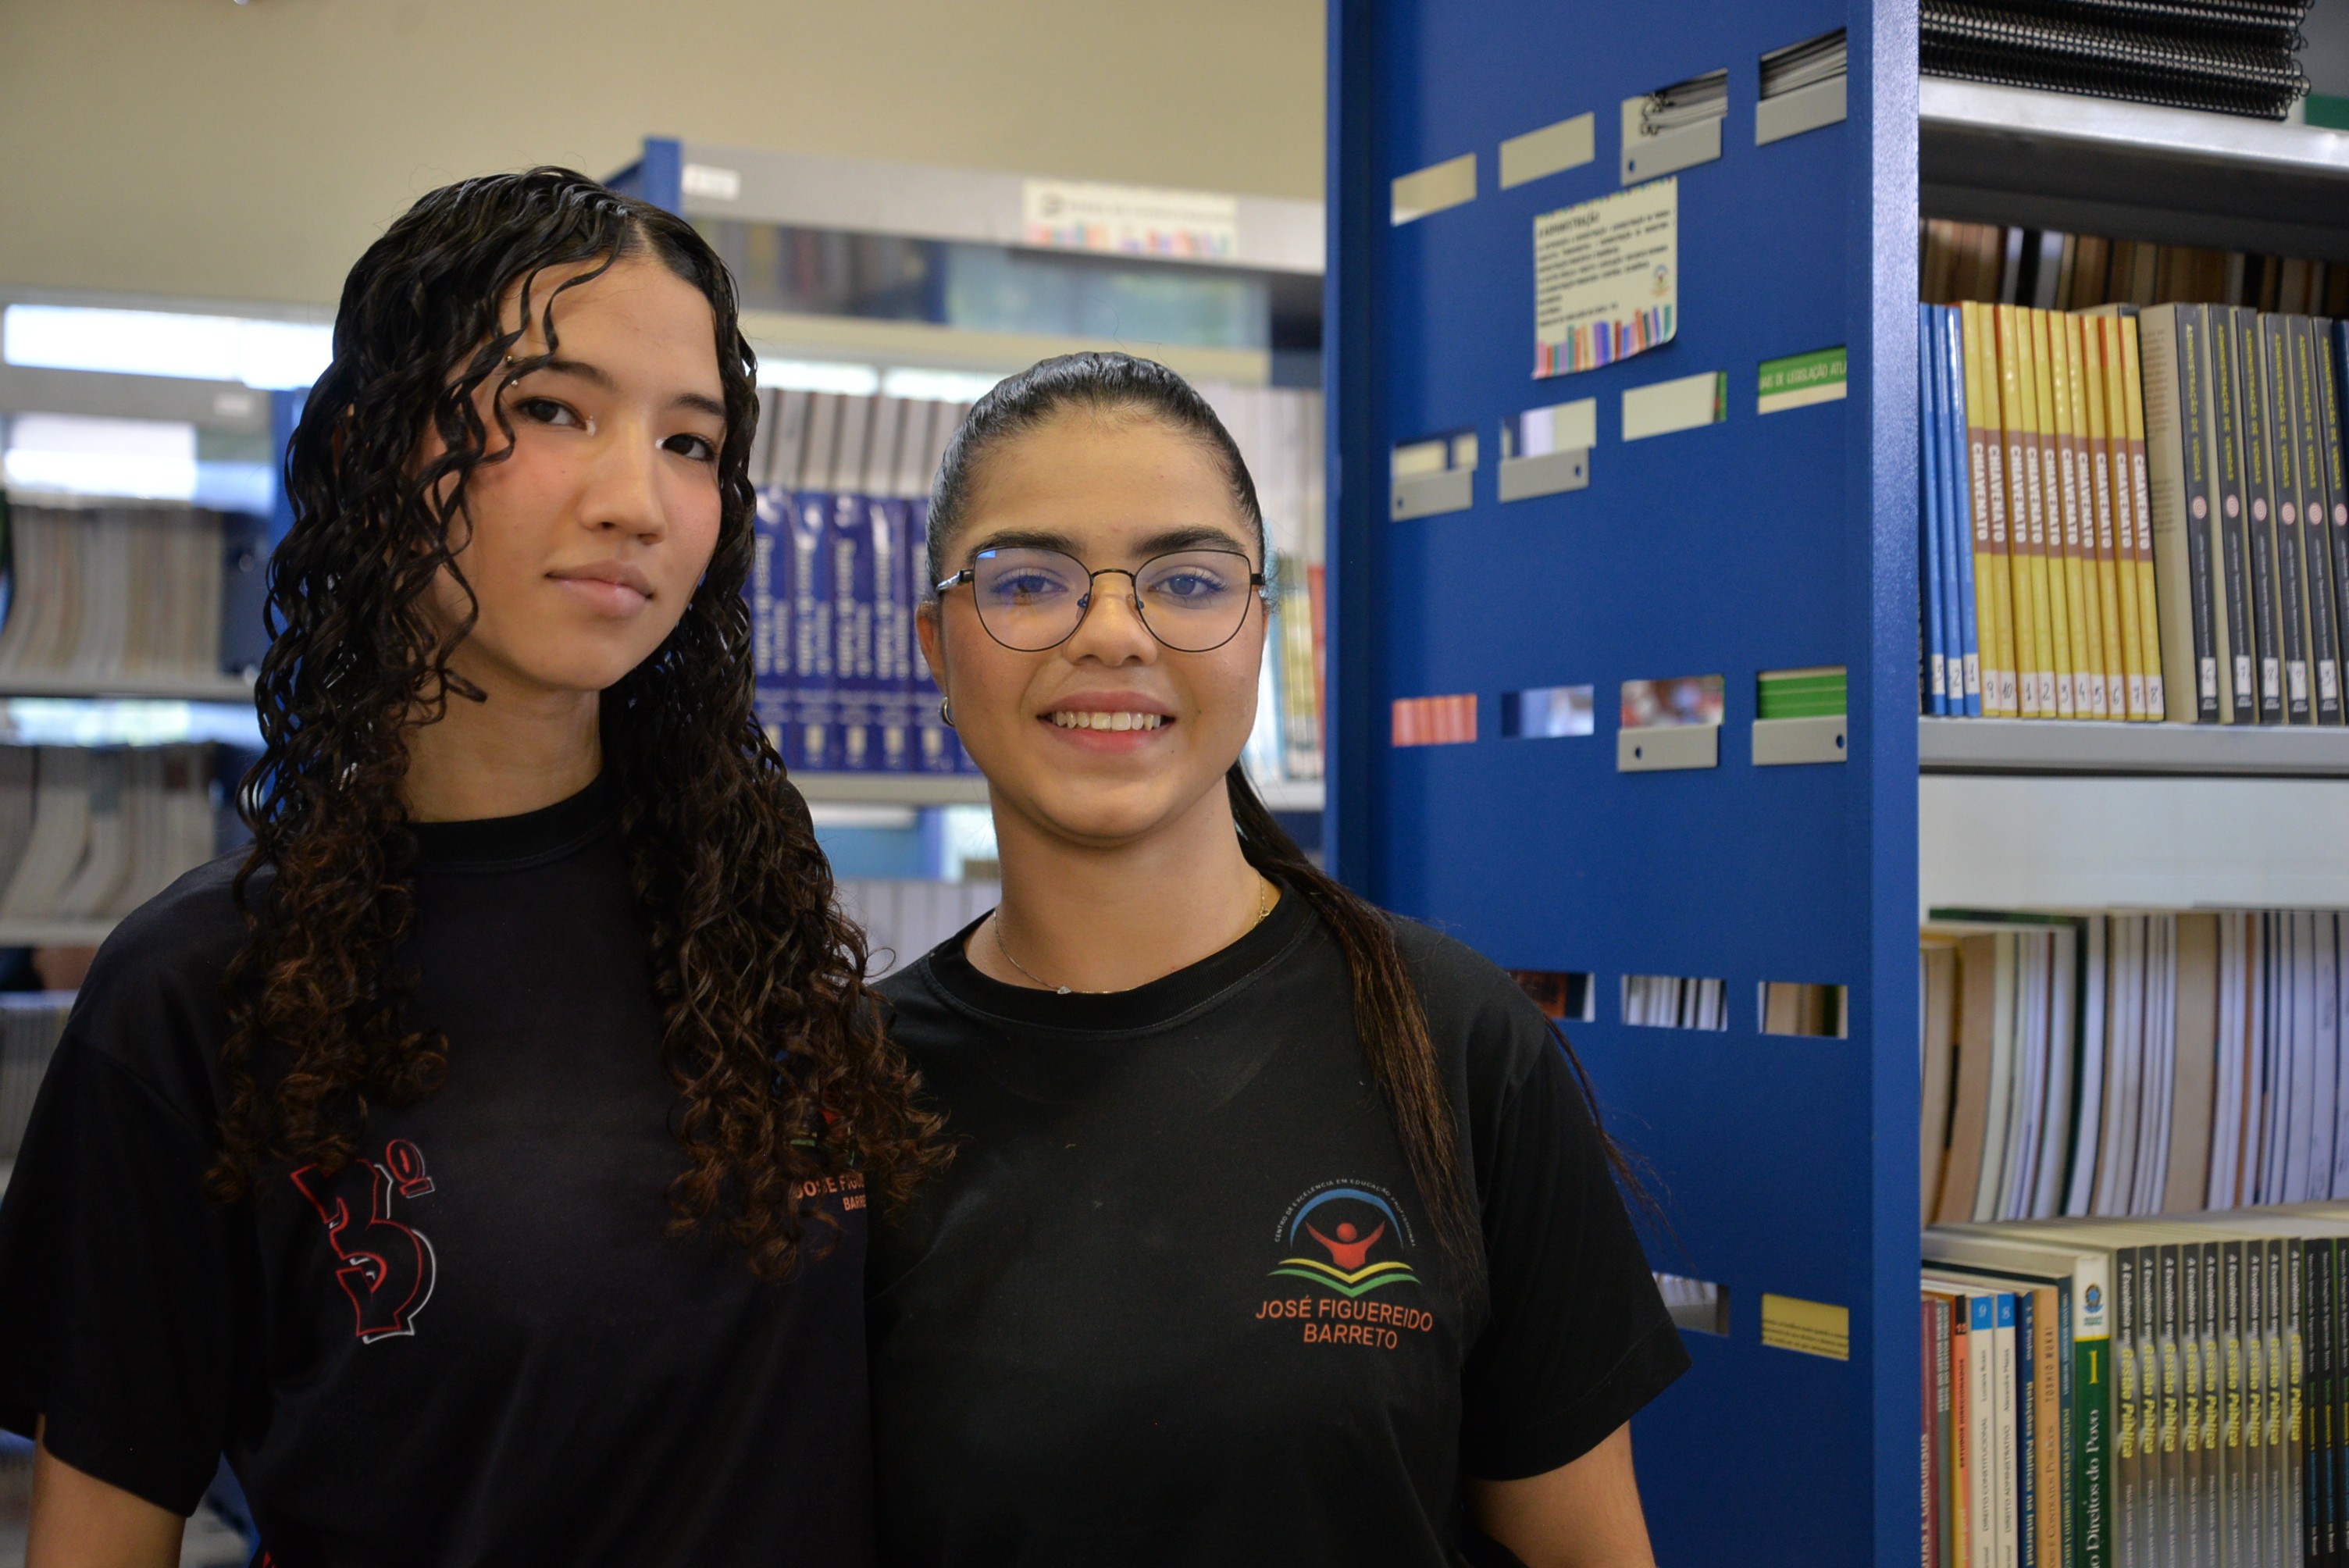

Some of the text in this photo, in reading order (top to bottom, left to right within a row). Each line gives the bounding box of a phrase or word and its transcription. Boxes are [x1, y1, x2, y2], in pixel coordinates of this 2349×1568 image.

[1973, 443, 1988, 540] CHIAVENATO
[1988, 445, 2005, 542] CHIAVENATO
[2010, 445, 2026, 543] CHIAVENATO
[2026, 447, 2043, 543] CHIAVENATO
[2044, 449, 2060, 545] CHIAVENATO
[2062, 448, 2078, 545] CHIAVENATO
[2078, 452, 2094, 548] CHIAVENATO
[2096, 453, 2112, 548] CHIAVENATO
[2116, 452, 2132, 548] CHIAVENATO
[2133, 454, 2150, 550] CHIAVENATO
[1274, 1216, 1288, 1242] CENTRO
[1285, 1206, 1293, 1215] DE
[1292, 1181, 1334, 1206] EXCELÊNCIA
[1350, 1179, 1390, 1196] EDUCAÇÃO
[1256, 1295, 1433, 1332] JOSÉ FIGUEREIDO
[1303, 1324, 1398, 1349] BARRETO
[2088, 1350, 2100, 1384] 1
[2085, 1409, 2099, 1452] Povo
[2086, 1458, 2100, 1481] do
[2086, 1483, 2100, 1551] Direitos
